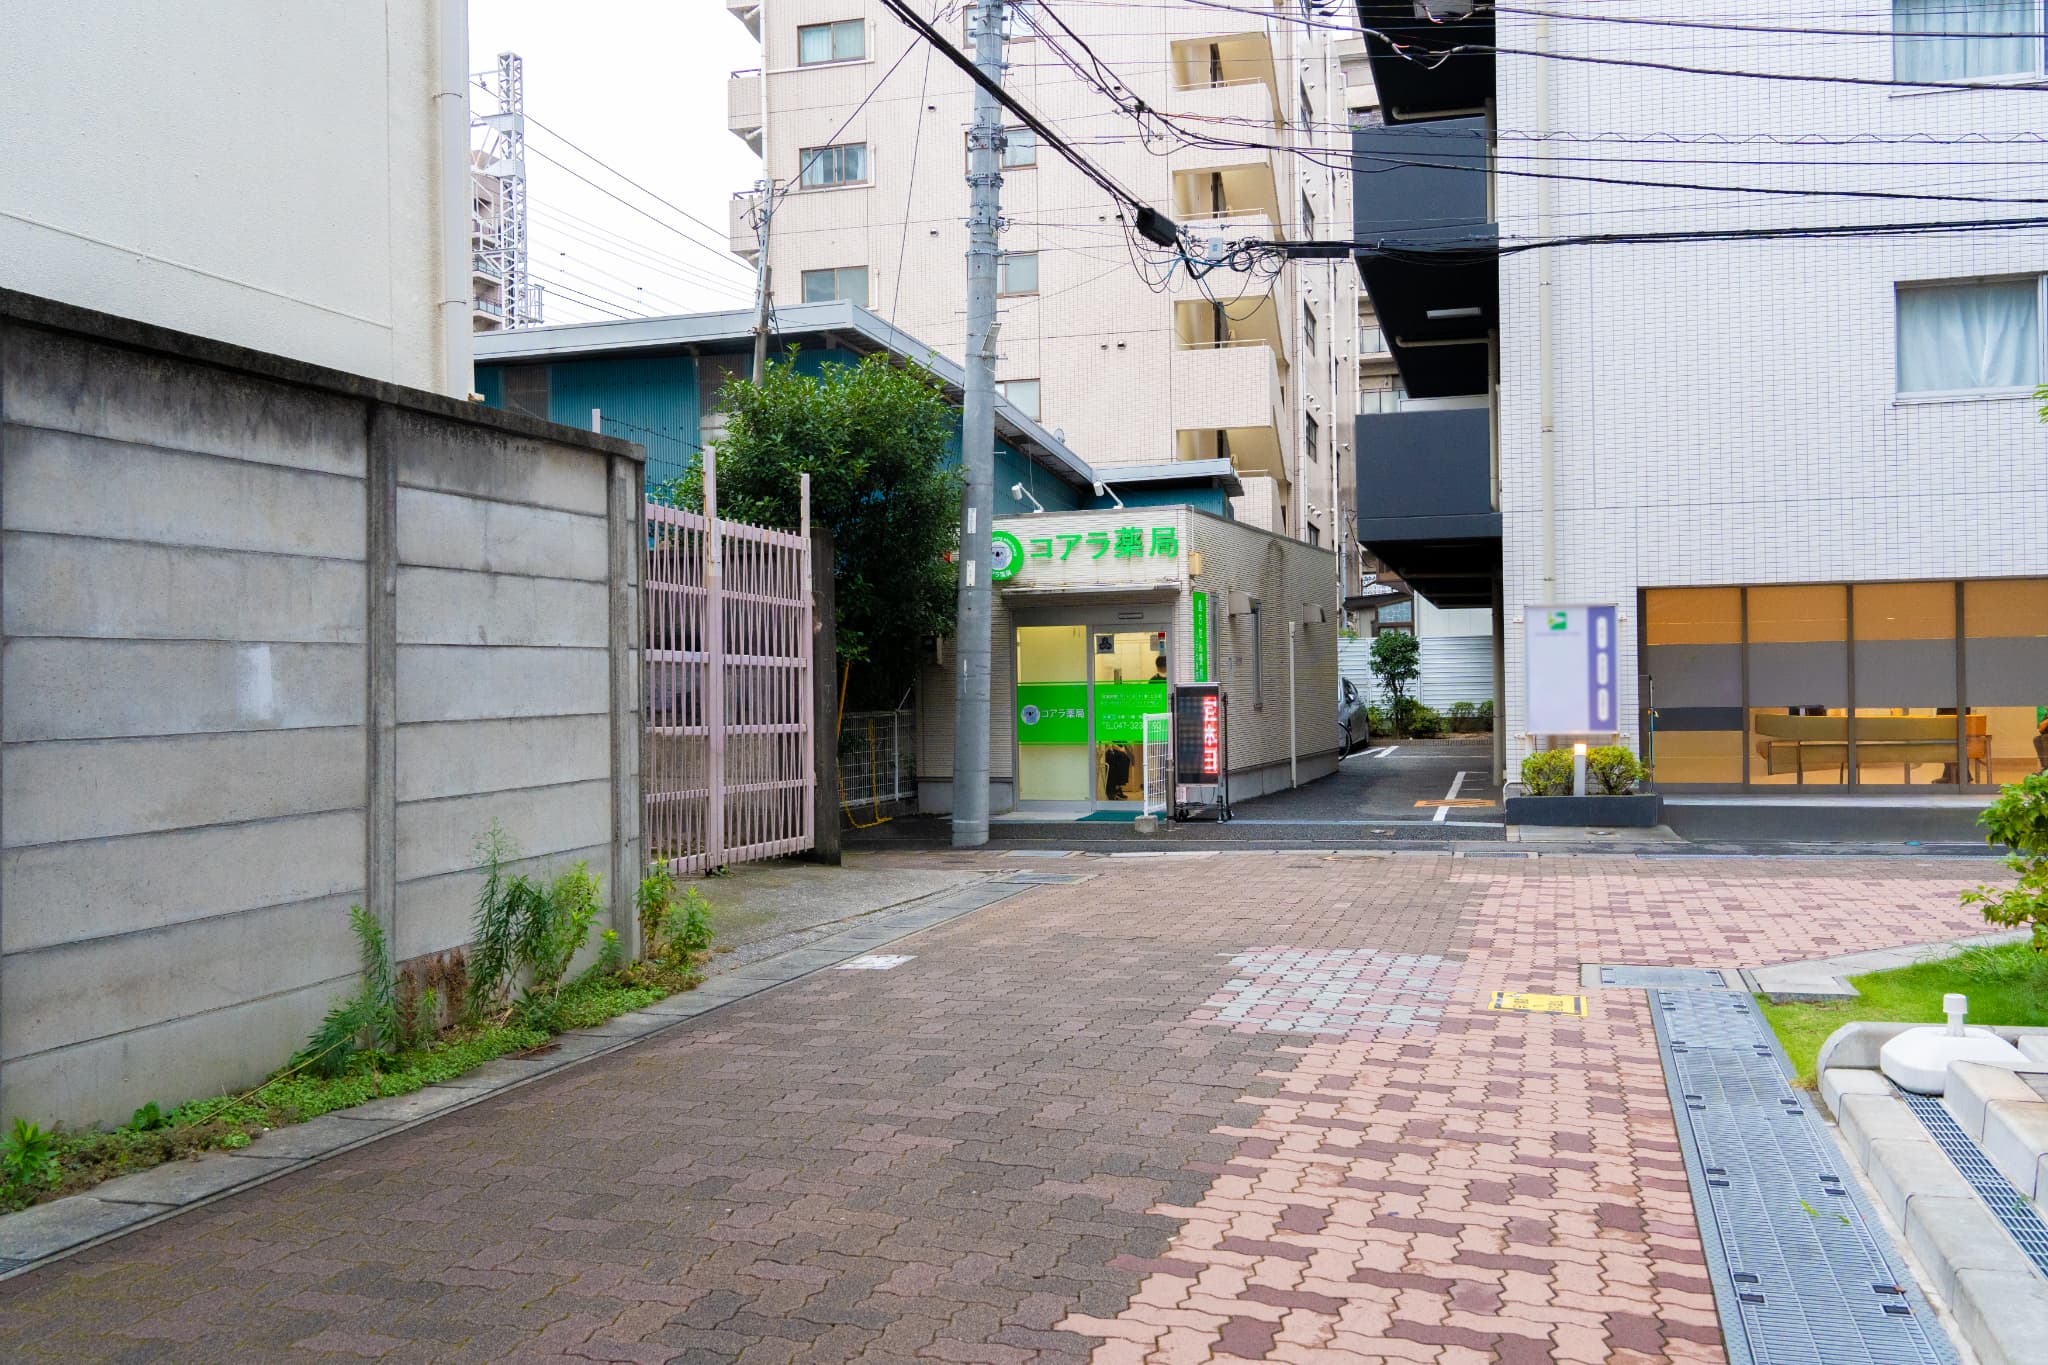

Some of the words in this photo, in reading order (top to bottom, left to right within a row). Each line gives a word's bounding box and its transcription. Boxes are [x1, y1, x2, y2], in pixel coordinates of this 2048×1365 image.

[1030, 527, 1179, 561] コアラ薬局
[1040, 708, 1085, 719] コアラ薬局
